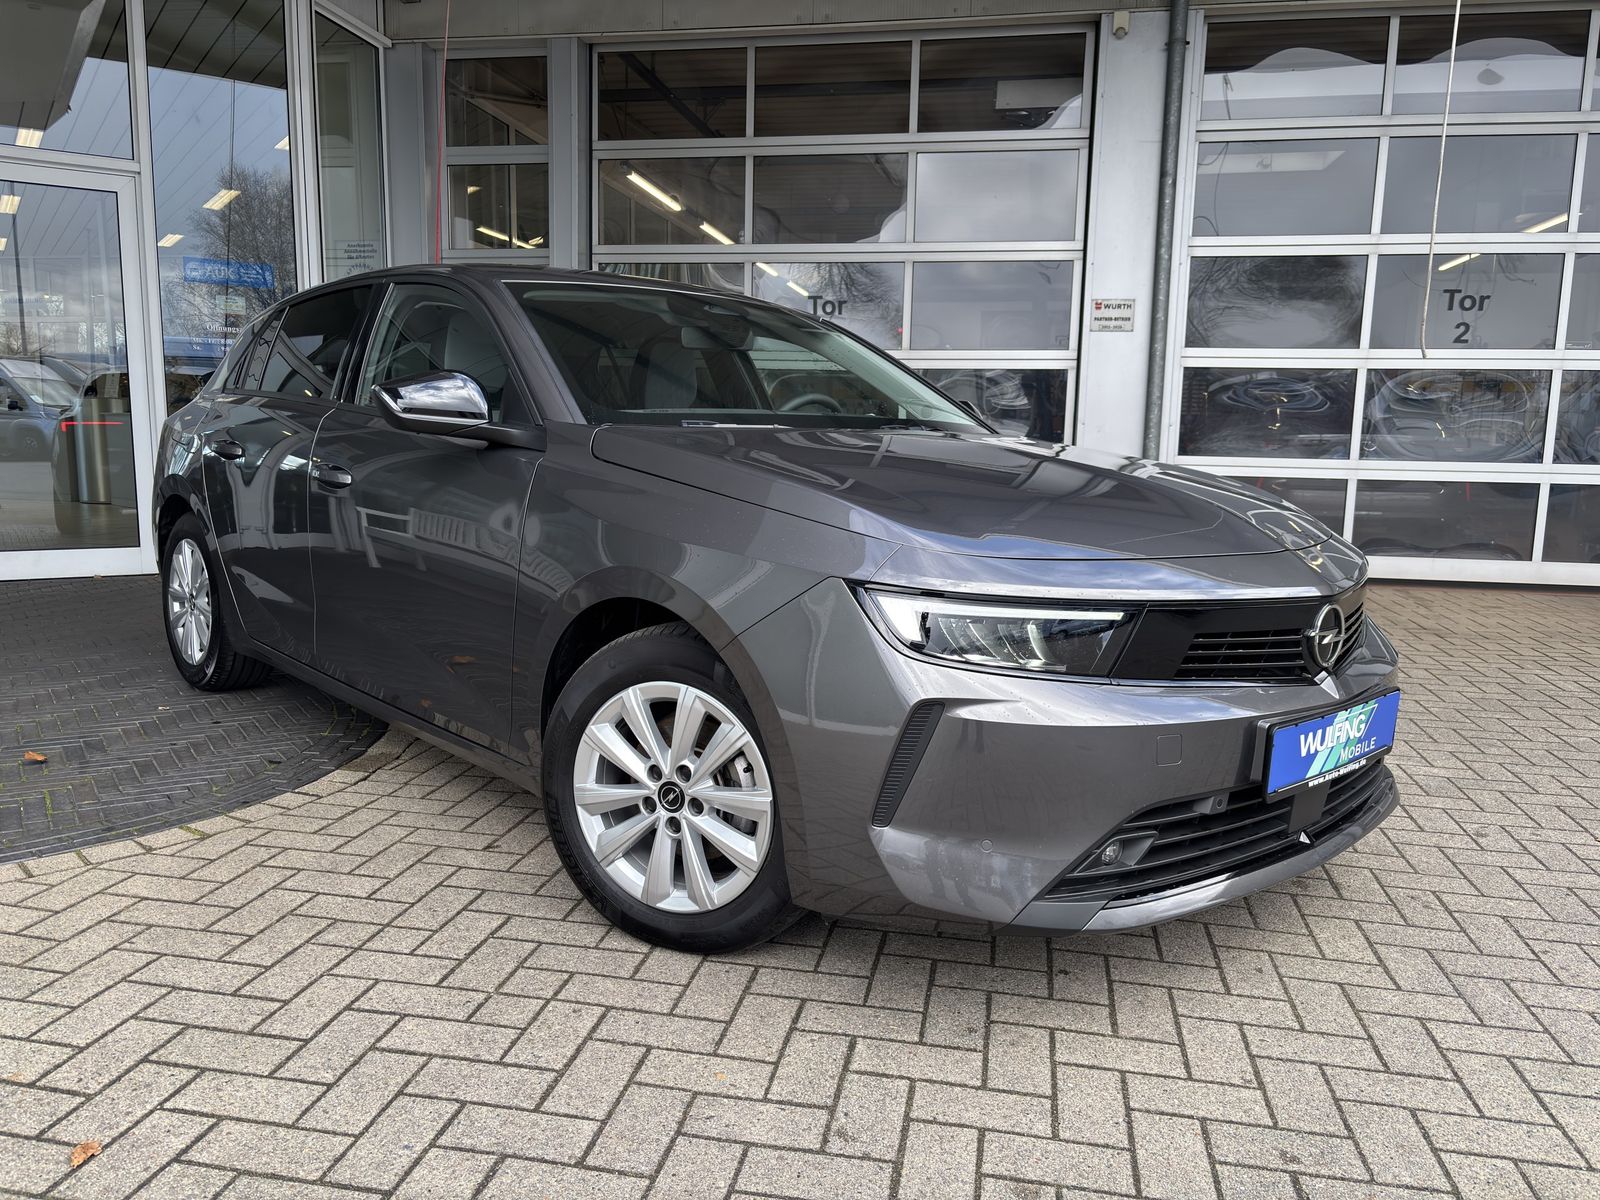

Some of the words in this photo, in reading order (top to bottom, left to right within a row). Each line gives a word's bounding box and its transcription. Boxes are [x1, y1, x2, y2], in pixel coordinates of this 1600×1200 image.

[808, 296, 847, 315] Tor
[1443, 289, 1491, 311] Tor
[1453, 322, 1470, 343] 2
[1339, 736, 1377, 762] MOBILE
